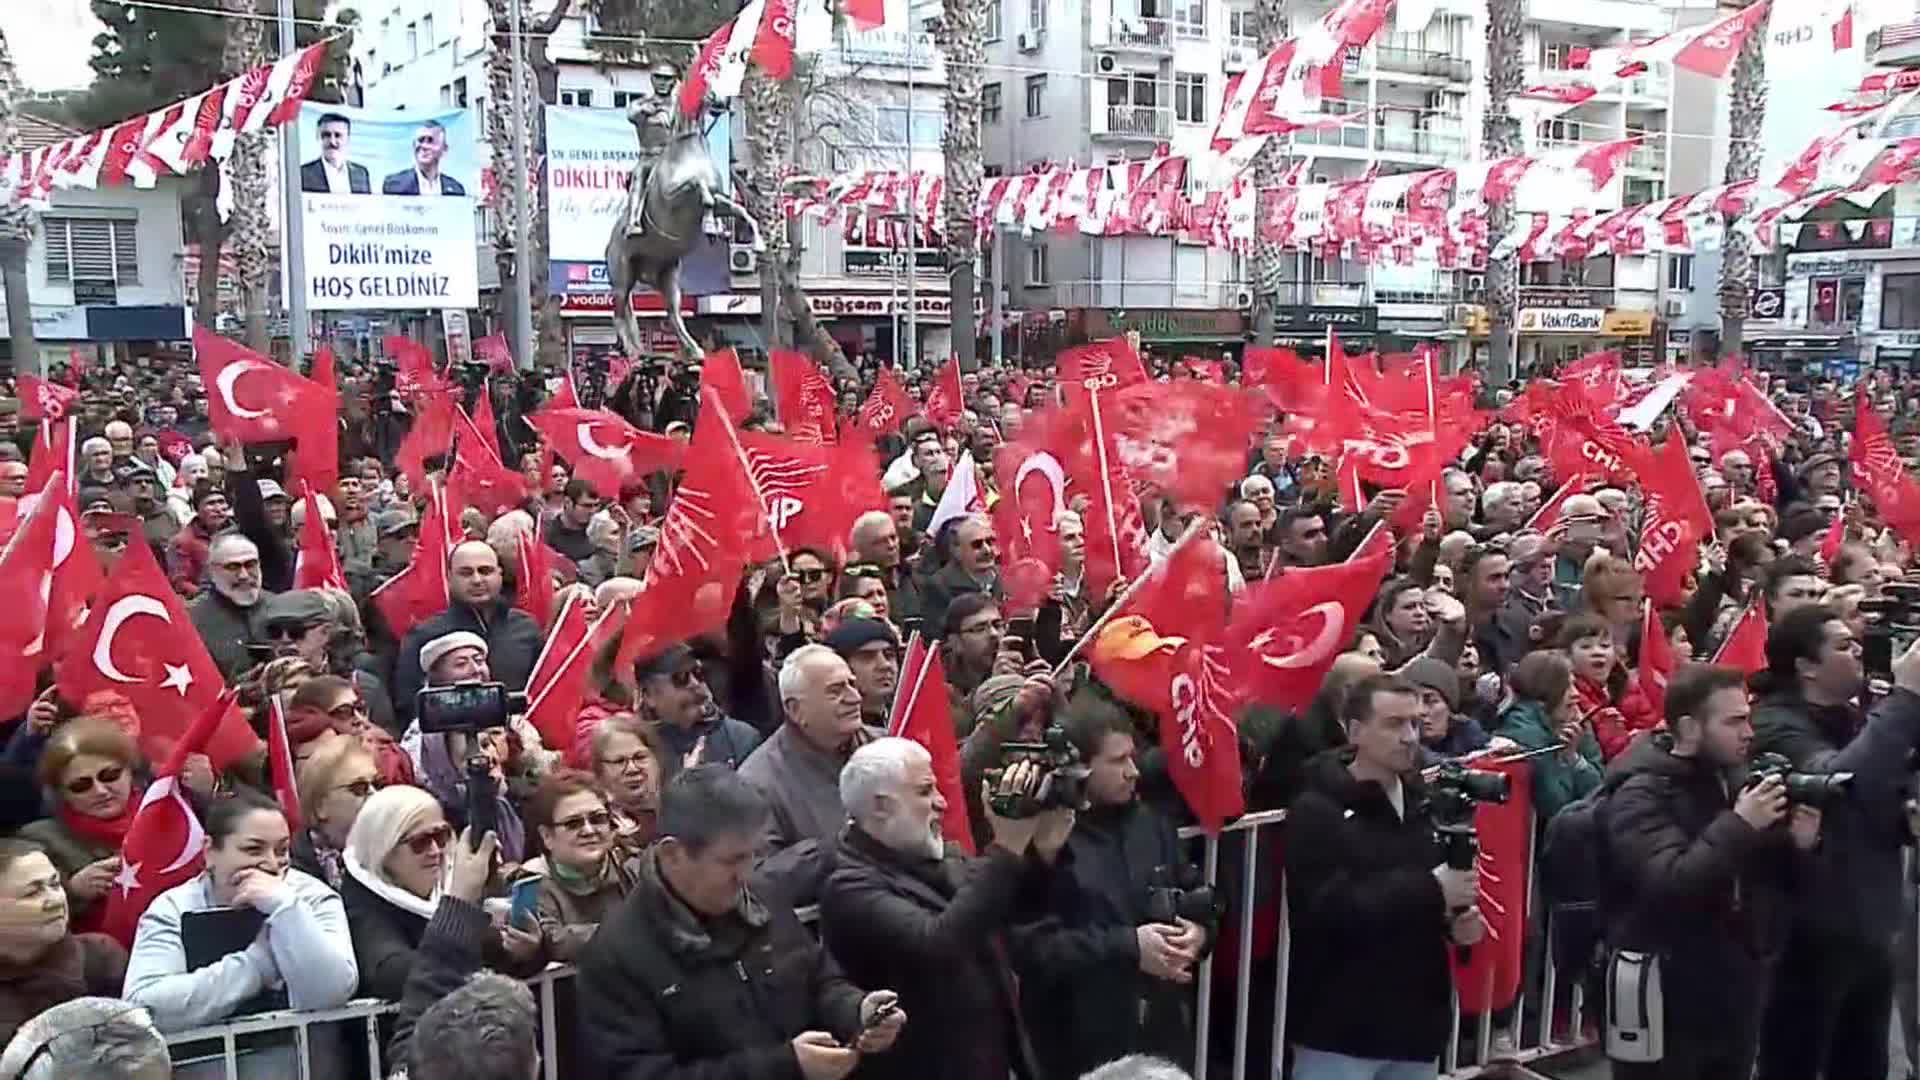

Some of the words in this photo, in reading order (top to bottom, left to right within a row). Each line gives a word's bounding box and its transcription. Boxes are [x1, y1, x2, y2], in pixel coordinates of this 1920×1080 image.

[329, 243, 433, 265] Dikili'mize
[313, 275, 354, 300] HOŞ
[359, 272, 450, 297] GELDİNİZ
